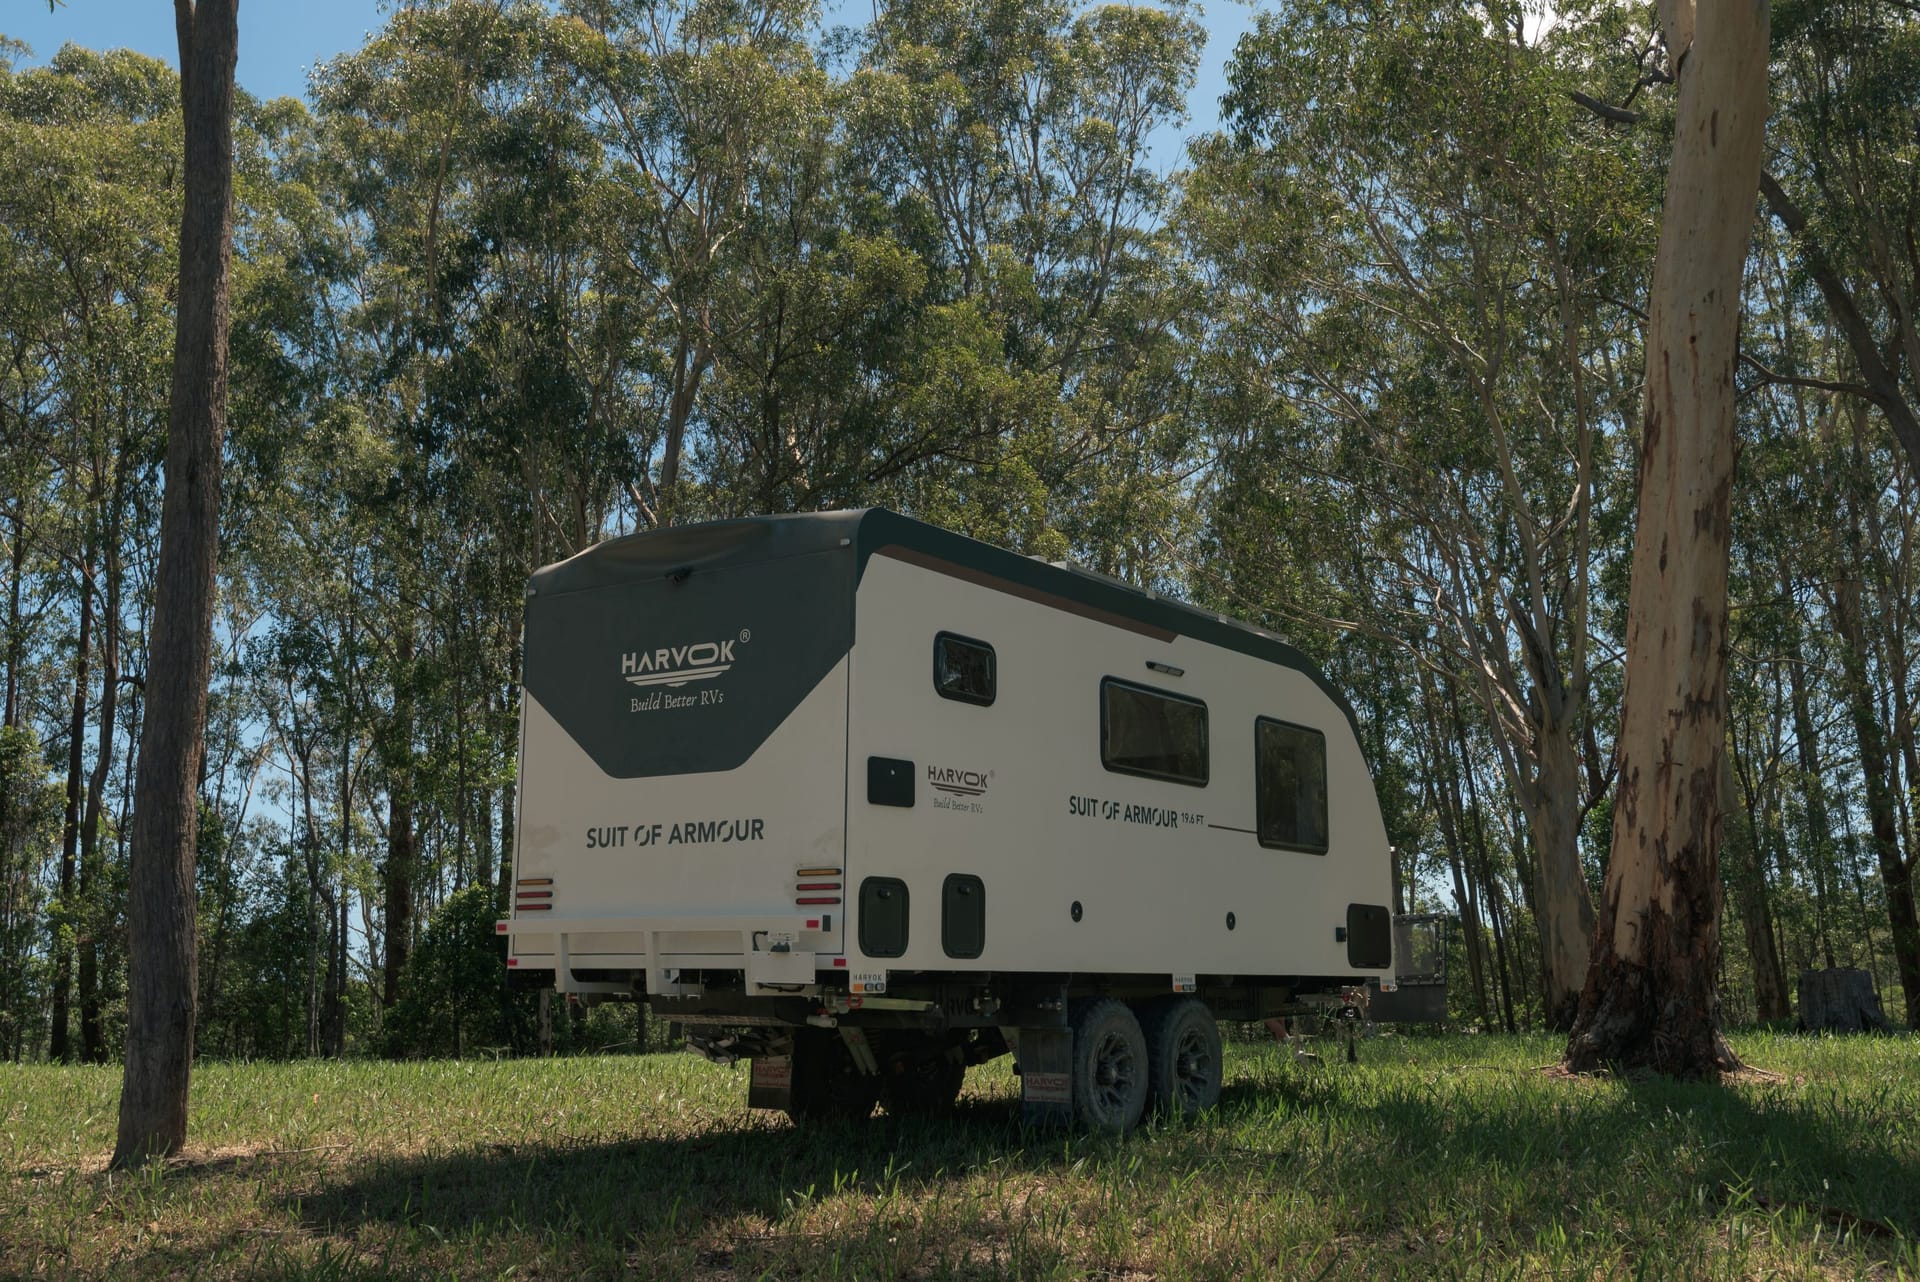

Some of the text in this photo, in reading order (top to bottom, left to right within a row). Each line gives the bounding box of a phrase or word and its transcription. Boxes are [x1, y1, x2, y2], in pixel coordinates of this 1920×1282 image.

[621, 640, 735, 674] HARVOK
[631, 689, 725, 712] Build Better RVs
[928, 765, 988, 788] HARVOK
[1069, 795, 1205, 829] SUIT OF ARMOUR 19.6 FT
[586, 819, 764, 848] SUIT OF ARMOUR
